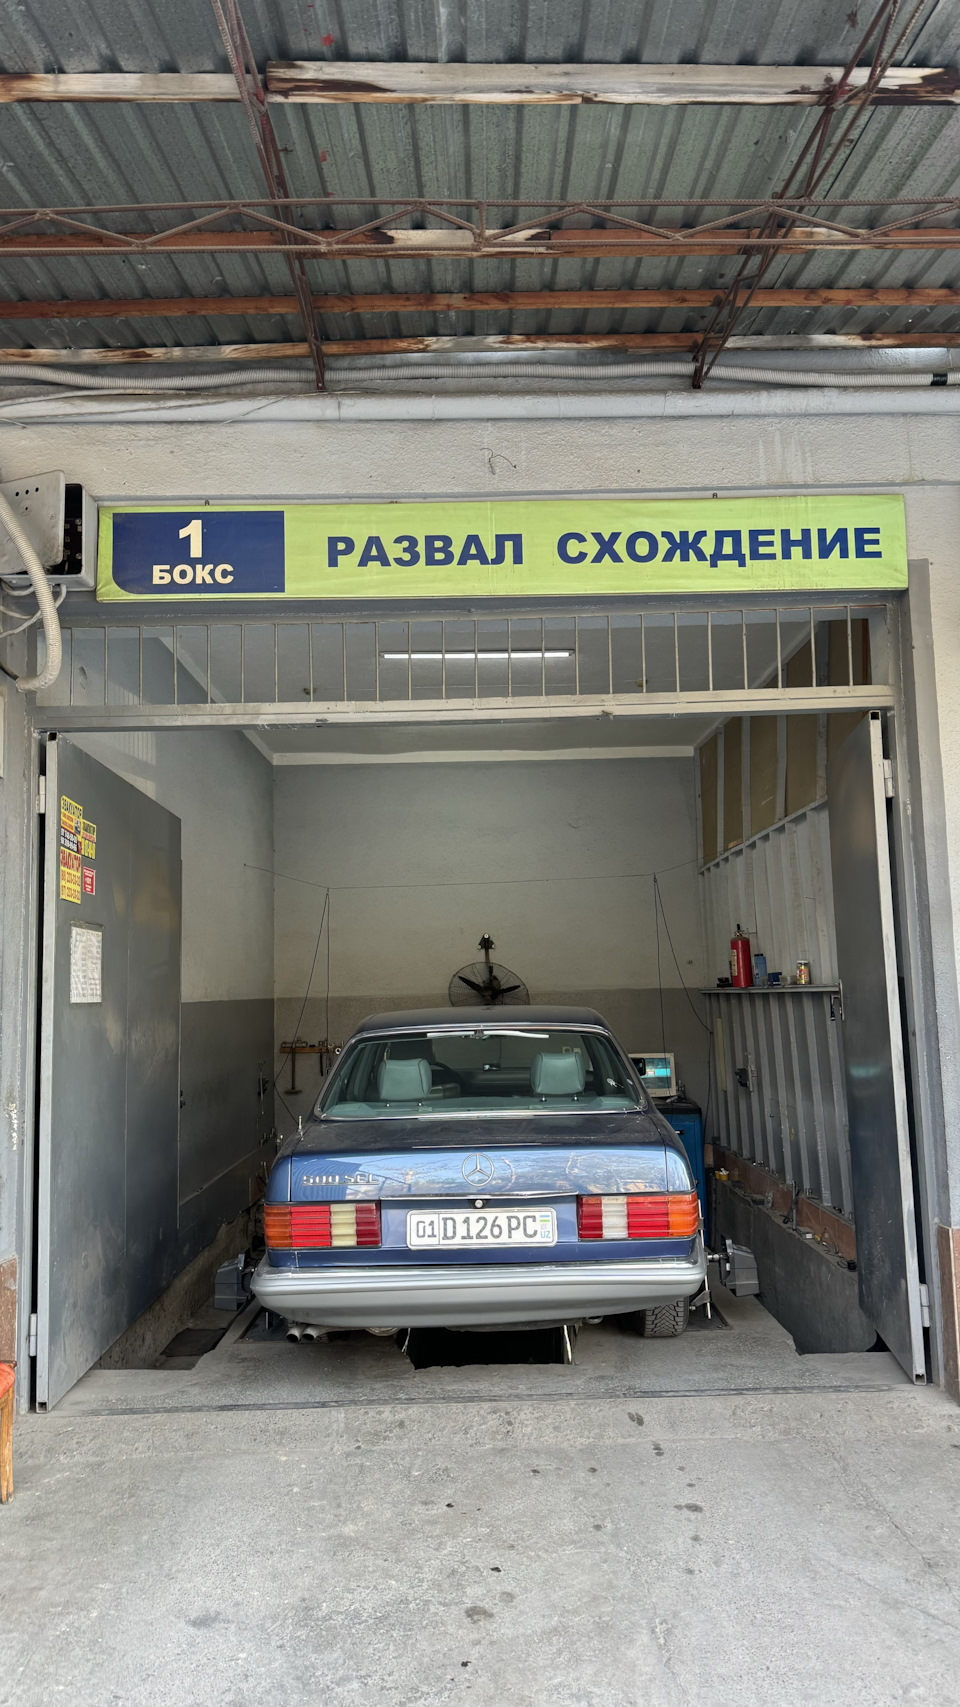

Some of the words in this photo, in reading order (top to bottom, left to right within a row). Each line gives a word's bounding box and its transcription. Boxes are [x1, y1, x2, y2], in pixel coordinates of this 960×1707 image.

[178, 519, 204, 558] 1
[327, 533, 524, 568] РАЗВАЛ
[556, 527, 883, 569] СХОЖДЕНИЕ
[152, 563, 234, 585] БОКС
[303, 1174, 340, 1185] 500
[344, 1173, 379, 1184] SEL
[416, 1220, 437, 1238] 01
[540, 1230, 551, 1239] UZ
